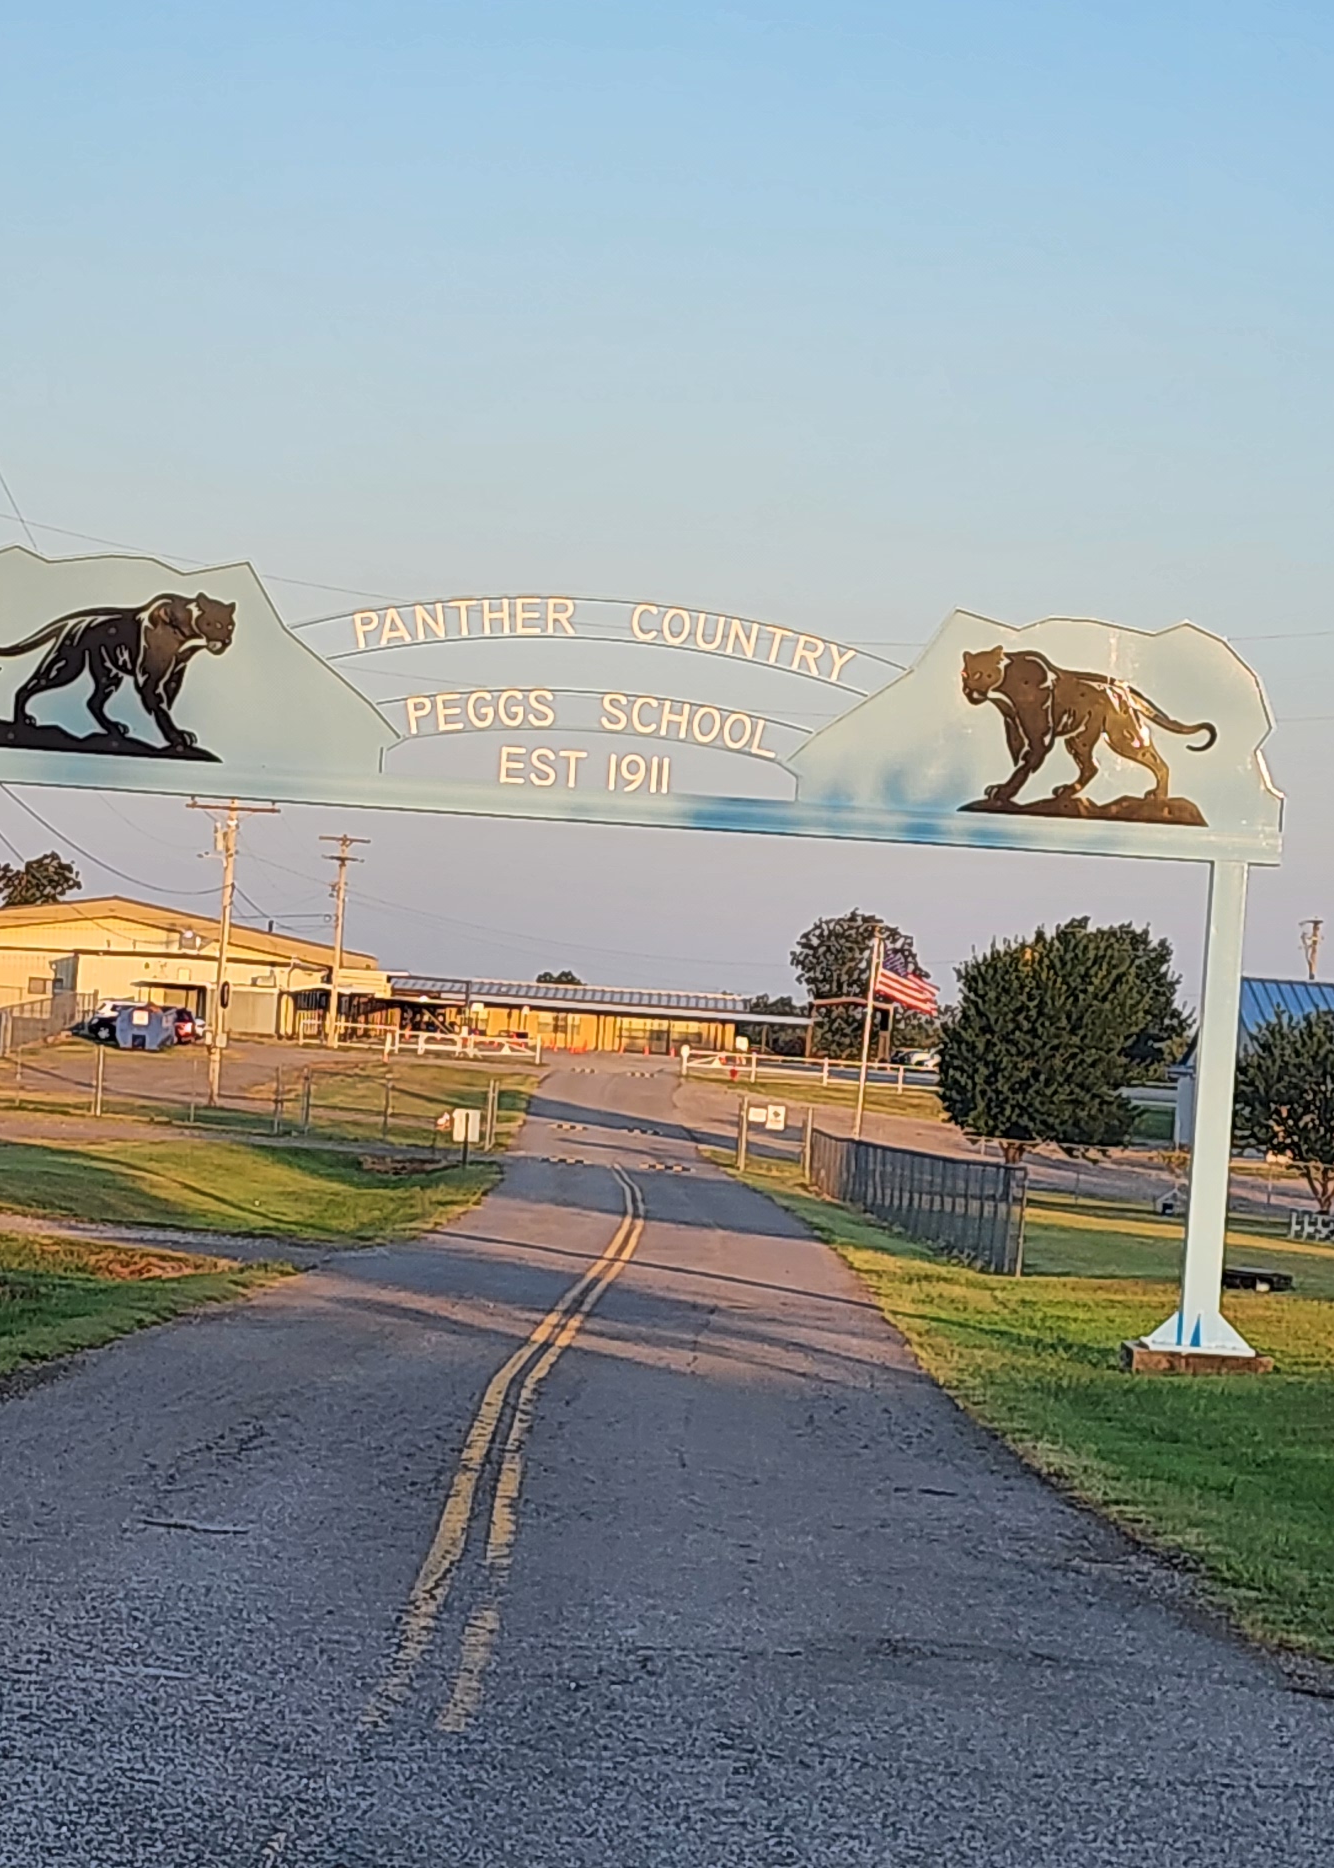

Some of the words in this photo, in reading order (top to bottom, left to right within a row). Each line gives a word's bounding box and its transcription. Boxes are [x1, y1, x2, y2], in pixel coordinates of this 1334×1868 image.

[353, 596, 576, 649] PANTHER
[630, 603, 856, 683] COUNTRY
[406, 688, 555, 735] PEGGS
[599, 693, 776, 758] SCHOOL
[498, 745, 587, 788] EST
[607, 753, 671, 795] 1911
